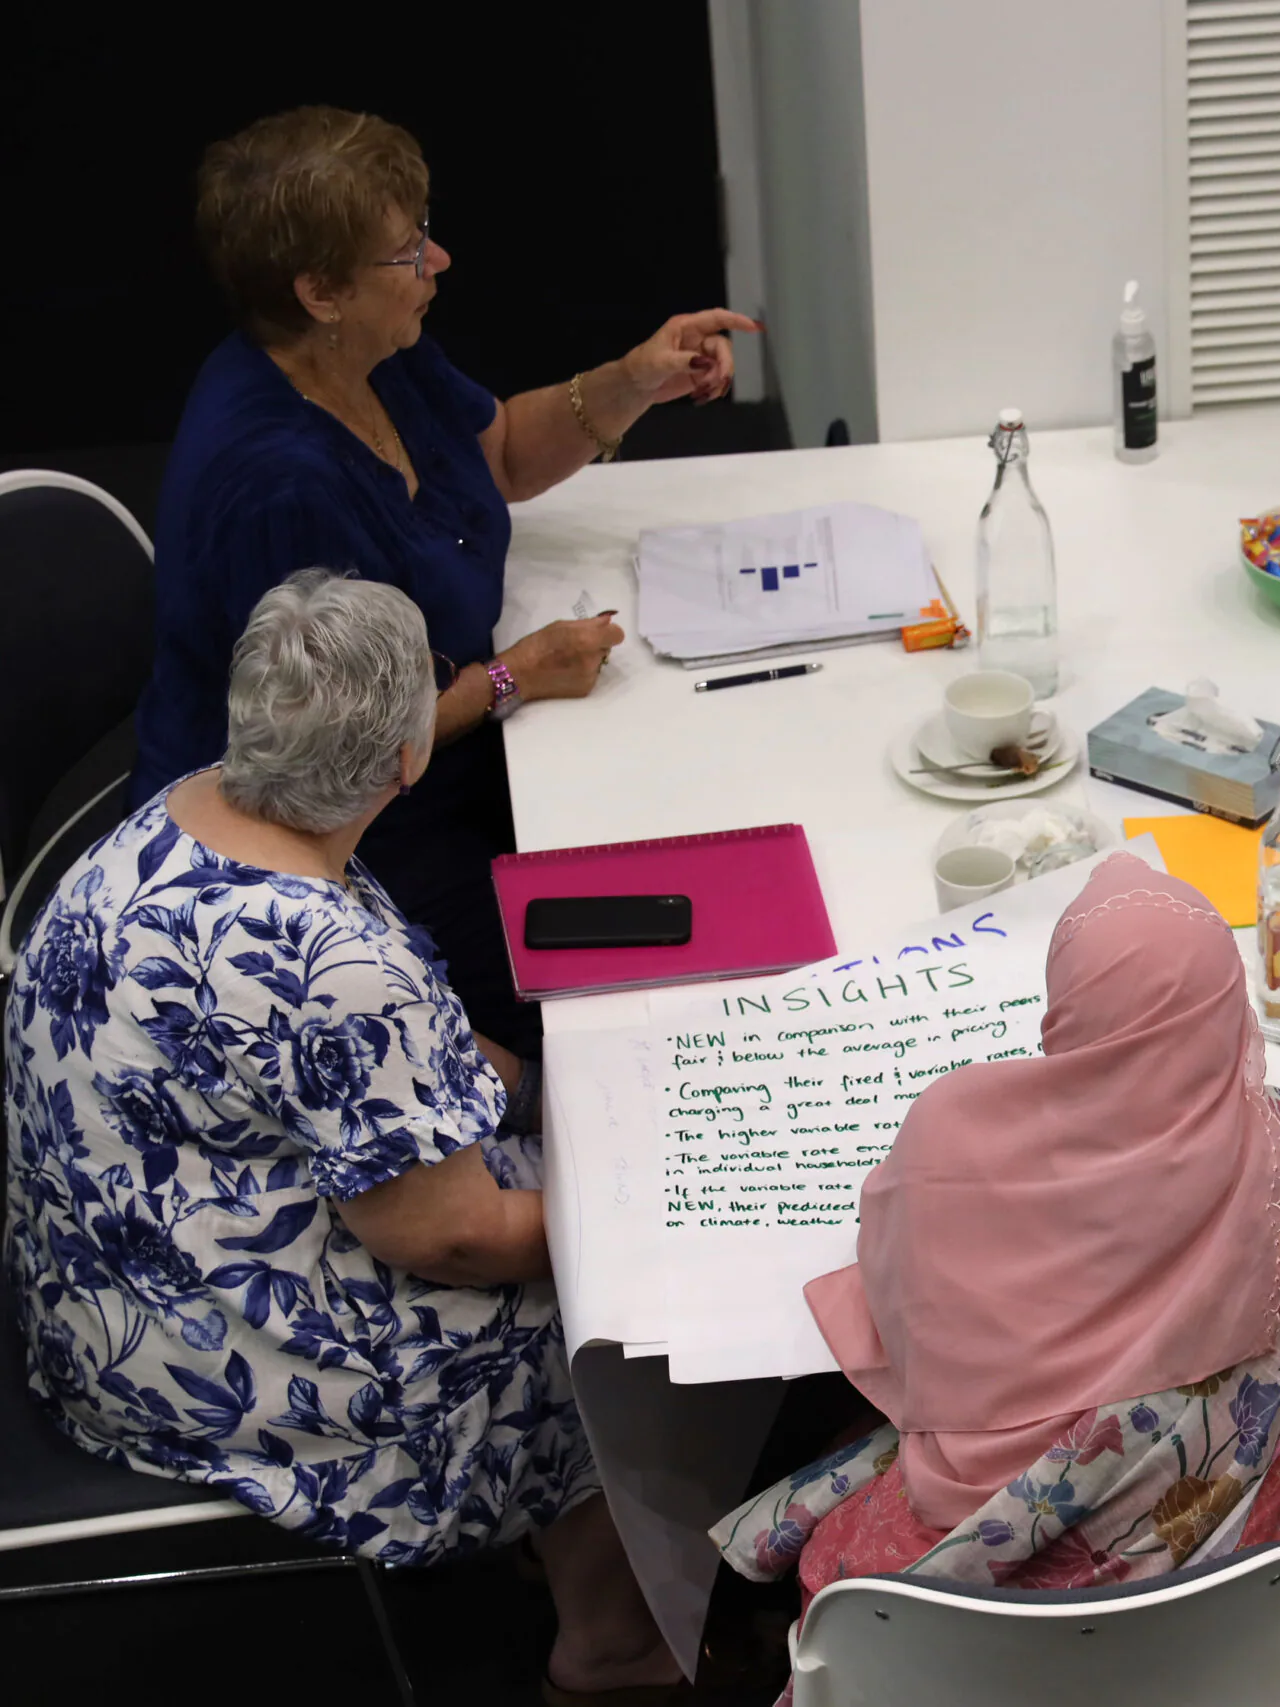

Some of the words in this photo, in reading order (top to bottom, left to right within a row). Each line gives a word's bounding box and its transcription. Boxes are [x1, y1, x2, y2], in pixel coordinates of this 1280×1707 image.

[722, 963, 975, 1017] INSIGHTS
[676, 1031, 725, 1050] NEW
[743, 1032, 762, 1042] in
[778, 1022, 875, 1045] comparison
[889, 1014, 930, 1027] with
[942, 1004, 987, 1019] their
[999, 994, 1042, 1013] peers
[672, 1054, 707, 1070] fair
[732, 1050, 784, 1063] below
[796, 1047, 830, 1058] the
[842, 1037, 918, 1059] average
[927, 1034, 941, 1042] in
[951, 1019, 1008, 1043] pricing
[679, 1081, 772, 1104] Comparing
[784, 1075, 824, 1089] their
[840, 1071, 884, 1093] fixed
[668, 1105, 745, 1123] charging
[759, 1104, 770, 1112] a
[786, 1098, 834, 1121] great
[844, 1093, 878, 1108] deal
[674, 1128, 705, 1143] The
[717, 1127, 779, 1147] higher
[790, 1122, 861, 1136] variable
[674, 1152, 711, 1165] The
[720, 1149, 791, 1162] variable
[801, 1146, 841, 1158] rate
[665, 1168, 685, 1177] in
[697, 1162, 783, 1176] individual
[675, 1184, 689, 1200] If
[700, 1184, 728, 1196] the
[739, 1181, 808, 1194] variable
[817, 1182, 854, 1193] rate
[667, 1199, 722, 1213] NEW,
[728, 1200, 768, 1213] their
[777, 1200, 857, 1215] predicted
[665, 1219, 686, 1228] on
[776, 1216, 844, 1227] weather
